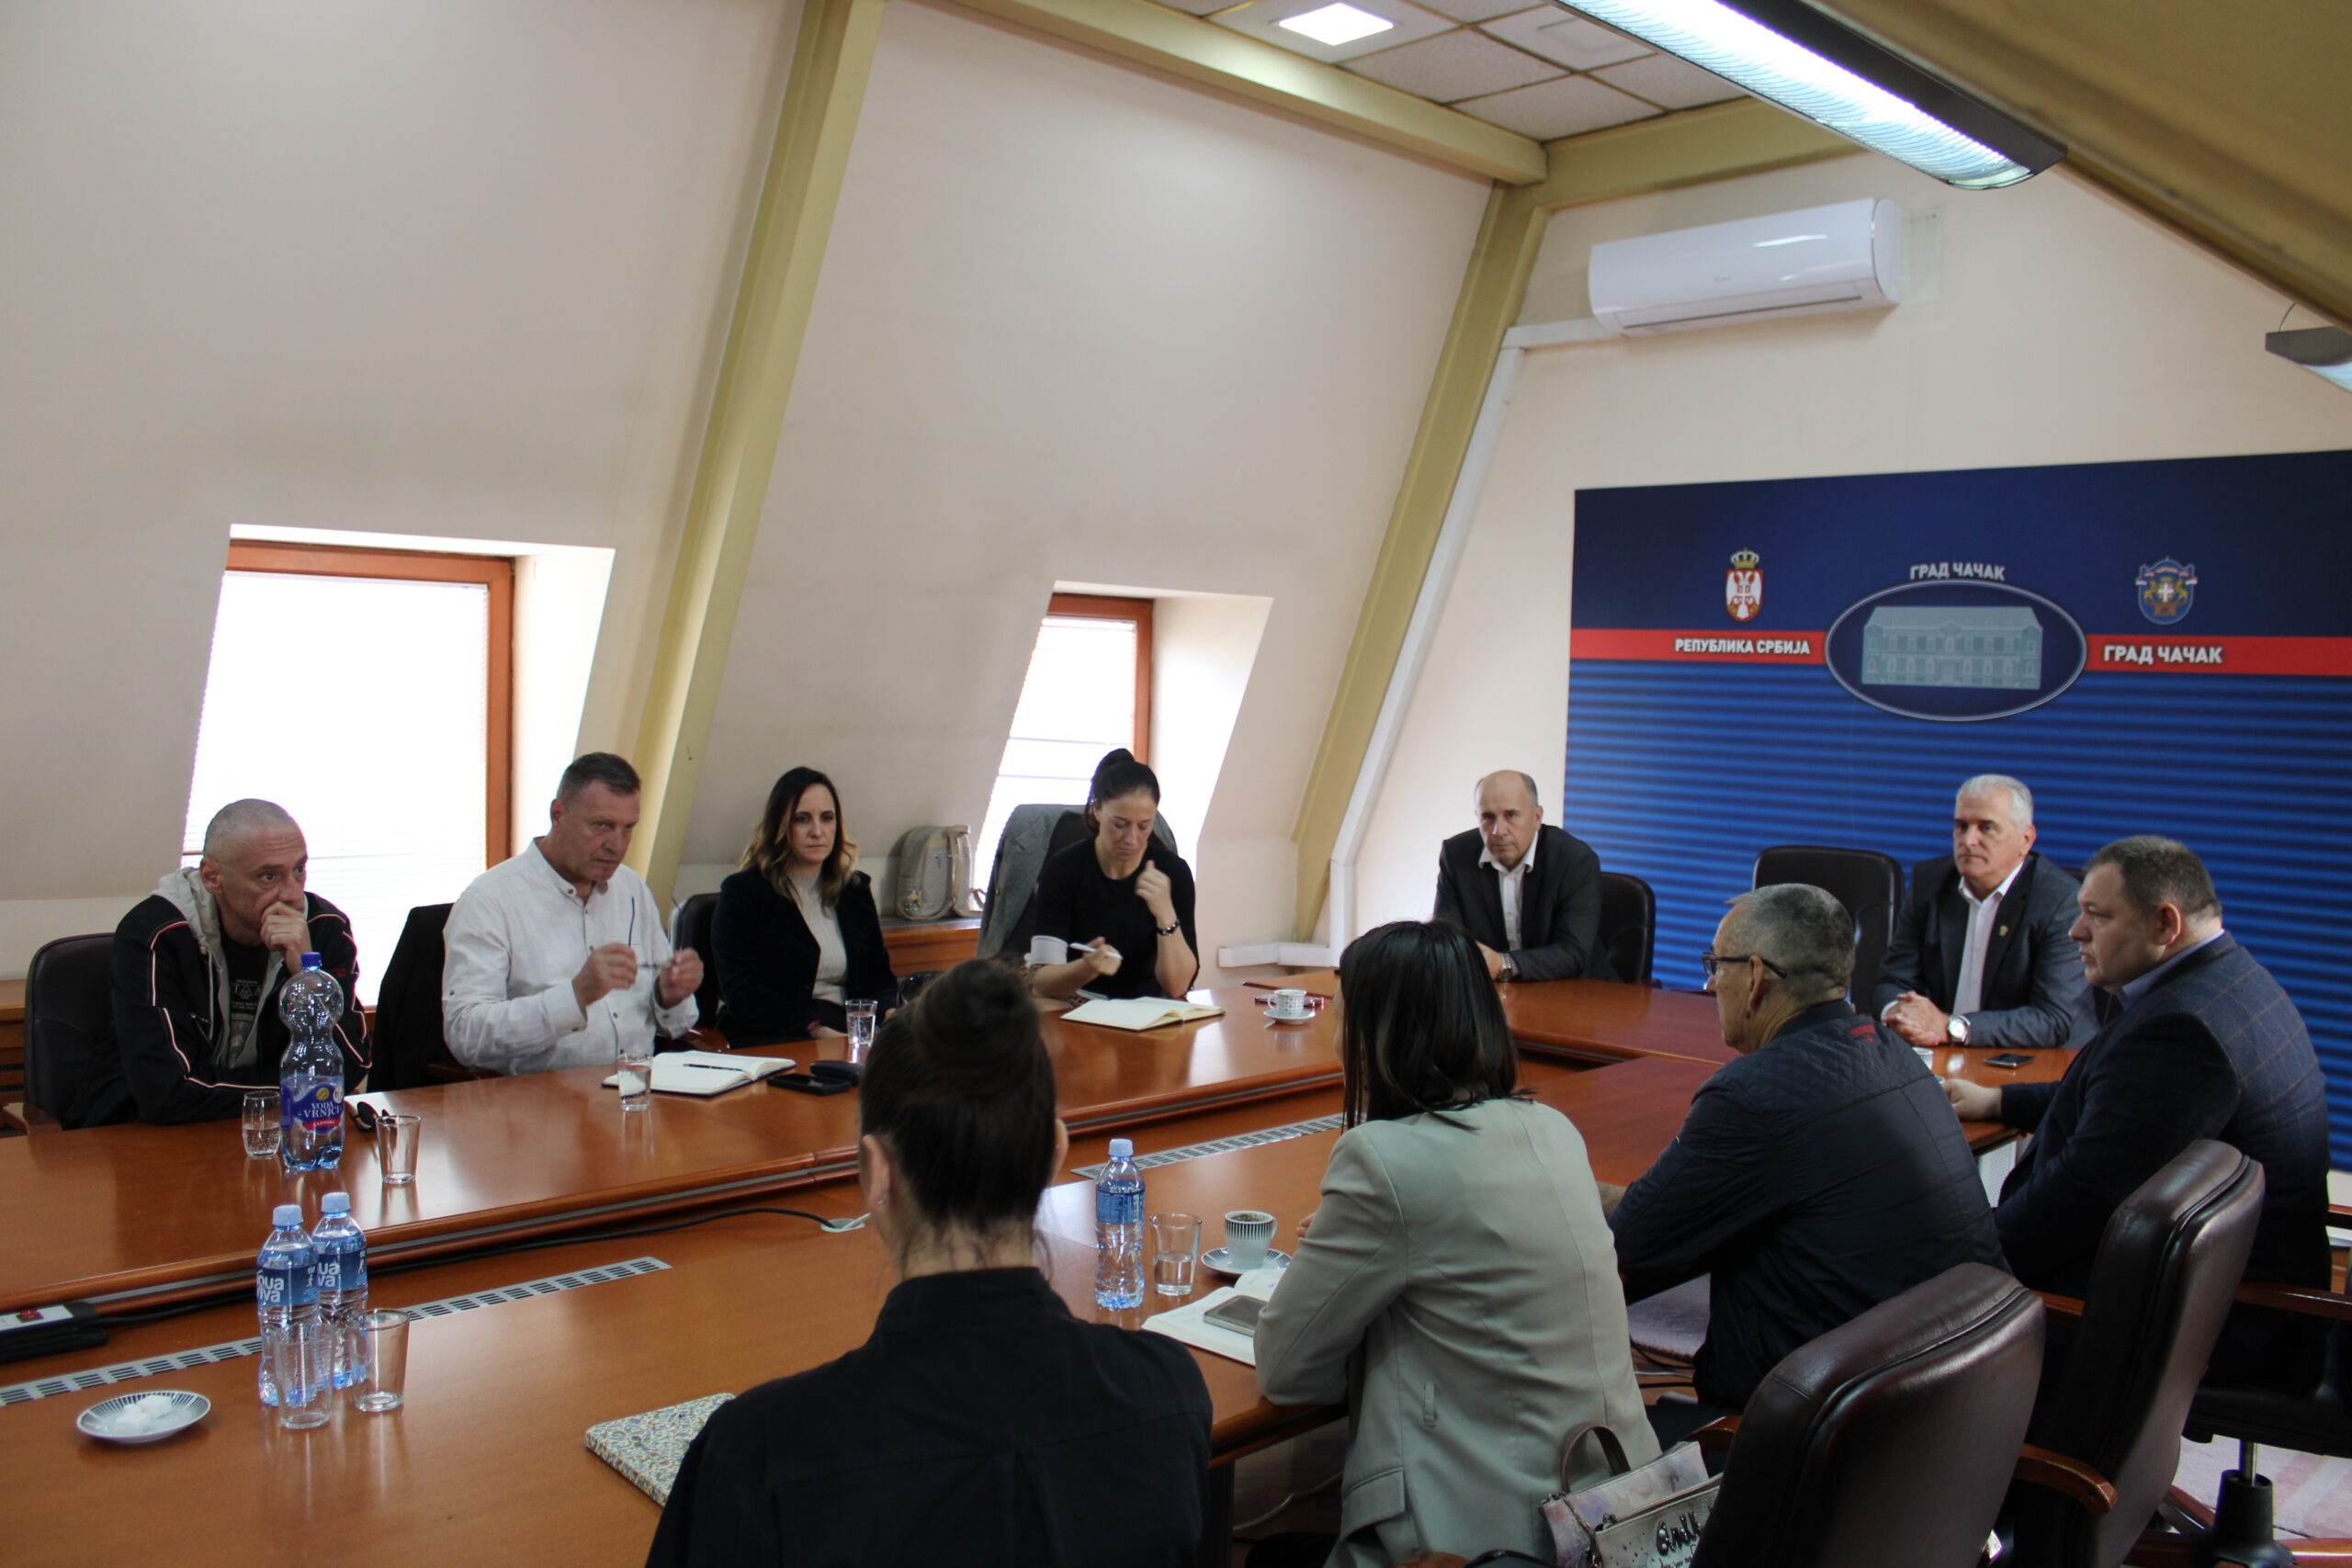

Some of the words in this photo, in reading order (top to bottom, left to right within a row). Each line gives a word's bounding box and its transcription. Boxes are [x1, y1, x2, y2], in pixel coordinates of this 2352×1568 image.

[1909, 562, 1950, 580] ГРАД
[1952, 562, 2006, 581] ЧАЧАК
[1674, 638, 1755, 653] РЕПУБЛИКА
[1756, 639, 1811, 654] СРБИЈА
[2103, 645, 2154, 665] ГРАД
[2157, 646, 2223, 663] ЧАЧАК
[311, 1101, 334, 1110] VODA
